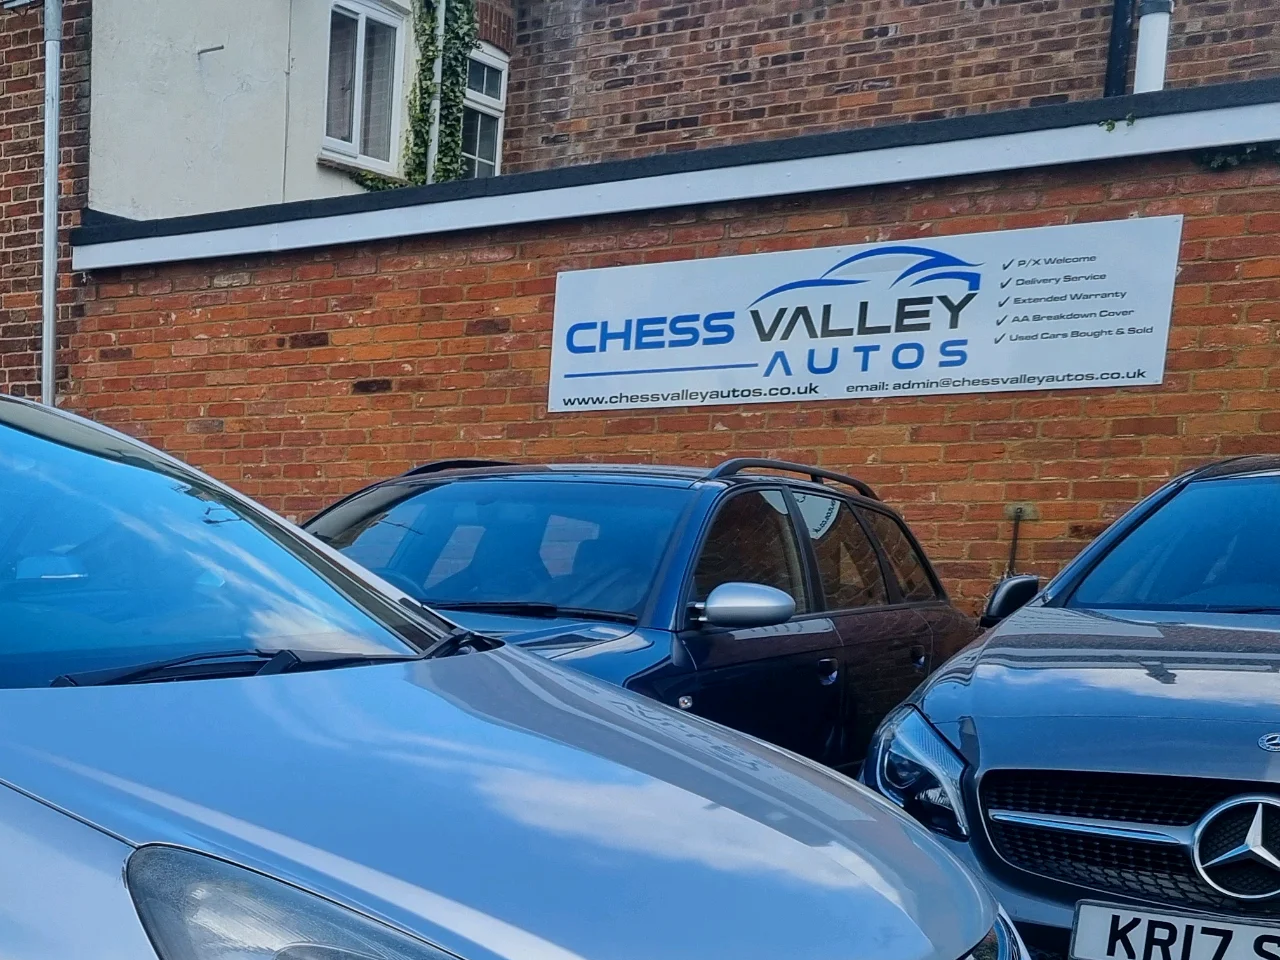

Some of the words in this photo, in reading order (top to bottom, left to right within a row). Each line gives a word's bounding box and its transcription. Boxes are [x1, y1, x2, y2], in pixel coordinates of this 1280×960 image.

[1018, 258, 1042, 268] P/X
[1044, 255, 1097, 266] Welcome
[1016, 275, 1061, 287] Delivery
[1063, 273, 1107, 283] Service
[1013, 294, 1068, 305] Extended
[1069, 290, 1127, 301] Warranty
[565, 311, 736, 354] CHESS
[749, 292, 980, 342] VALLEY
[1011, 314, 1030, 323] AA
[1032, 312, 1097, 322] Breakdown
[1099, 309, 1135, 318] Cover
[1009, 332, 1039, 342] Used
[1040, 331, 1068, 340] Cars
[1070, 328, 1113, 338] Bought
[1115, 327, 1126, 336] &
[1127, 326, 1154, 335] Sold
[762, 339, 969, 378] AUTOS
[846, 380, 890, 393] email:
[892, 368, 1148, 391] admin@chessvalleyautos.co.uk
[563, 382, 820, 406] www.chessvalleyautos.co.uk
